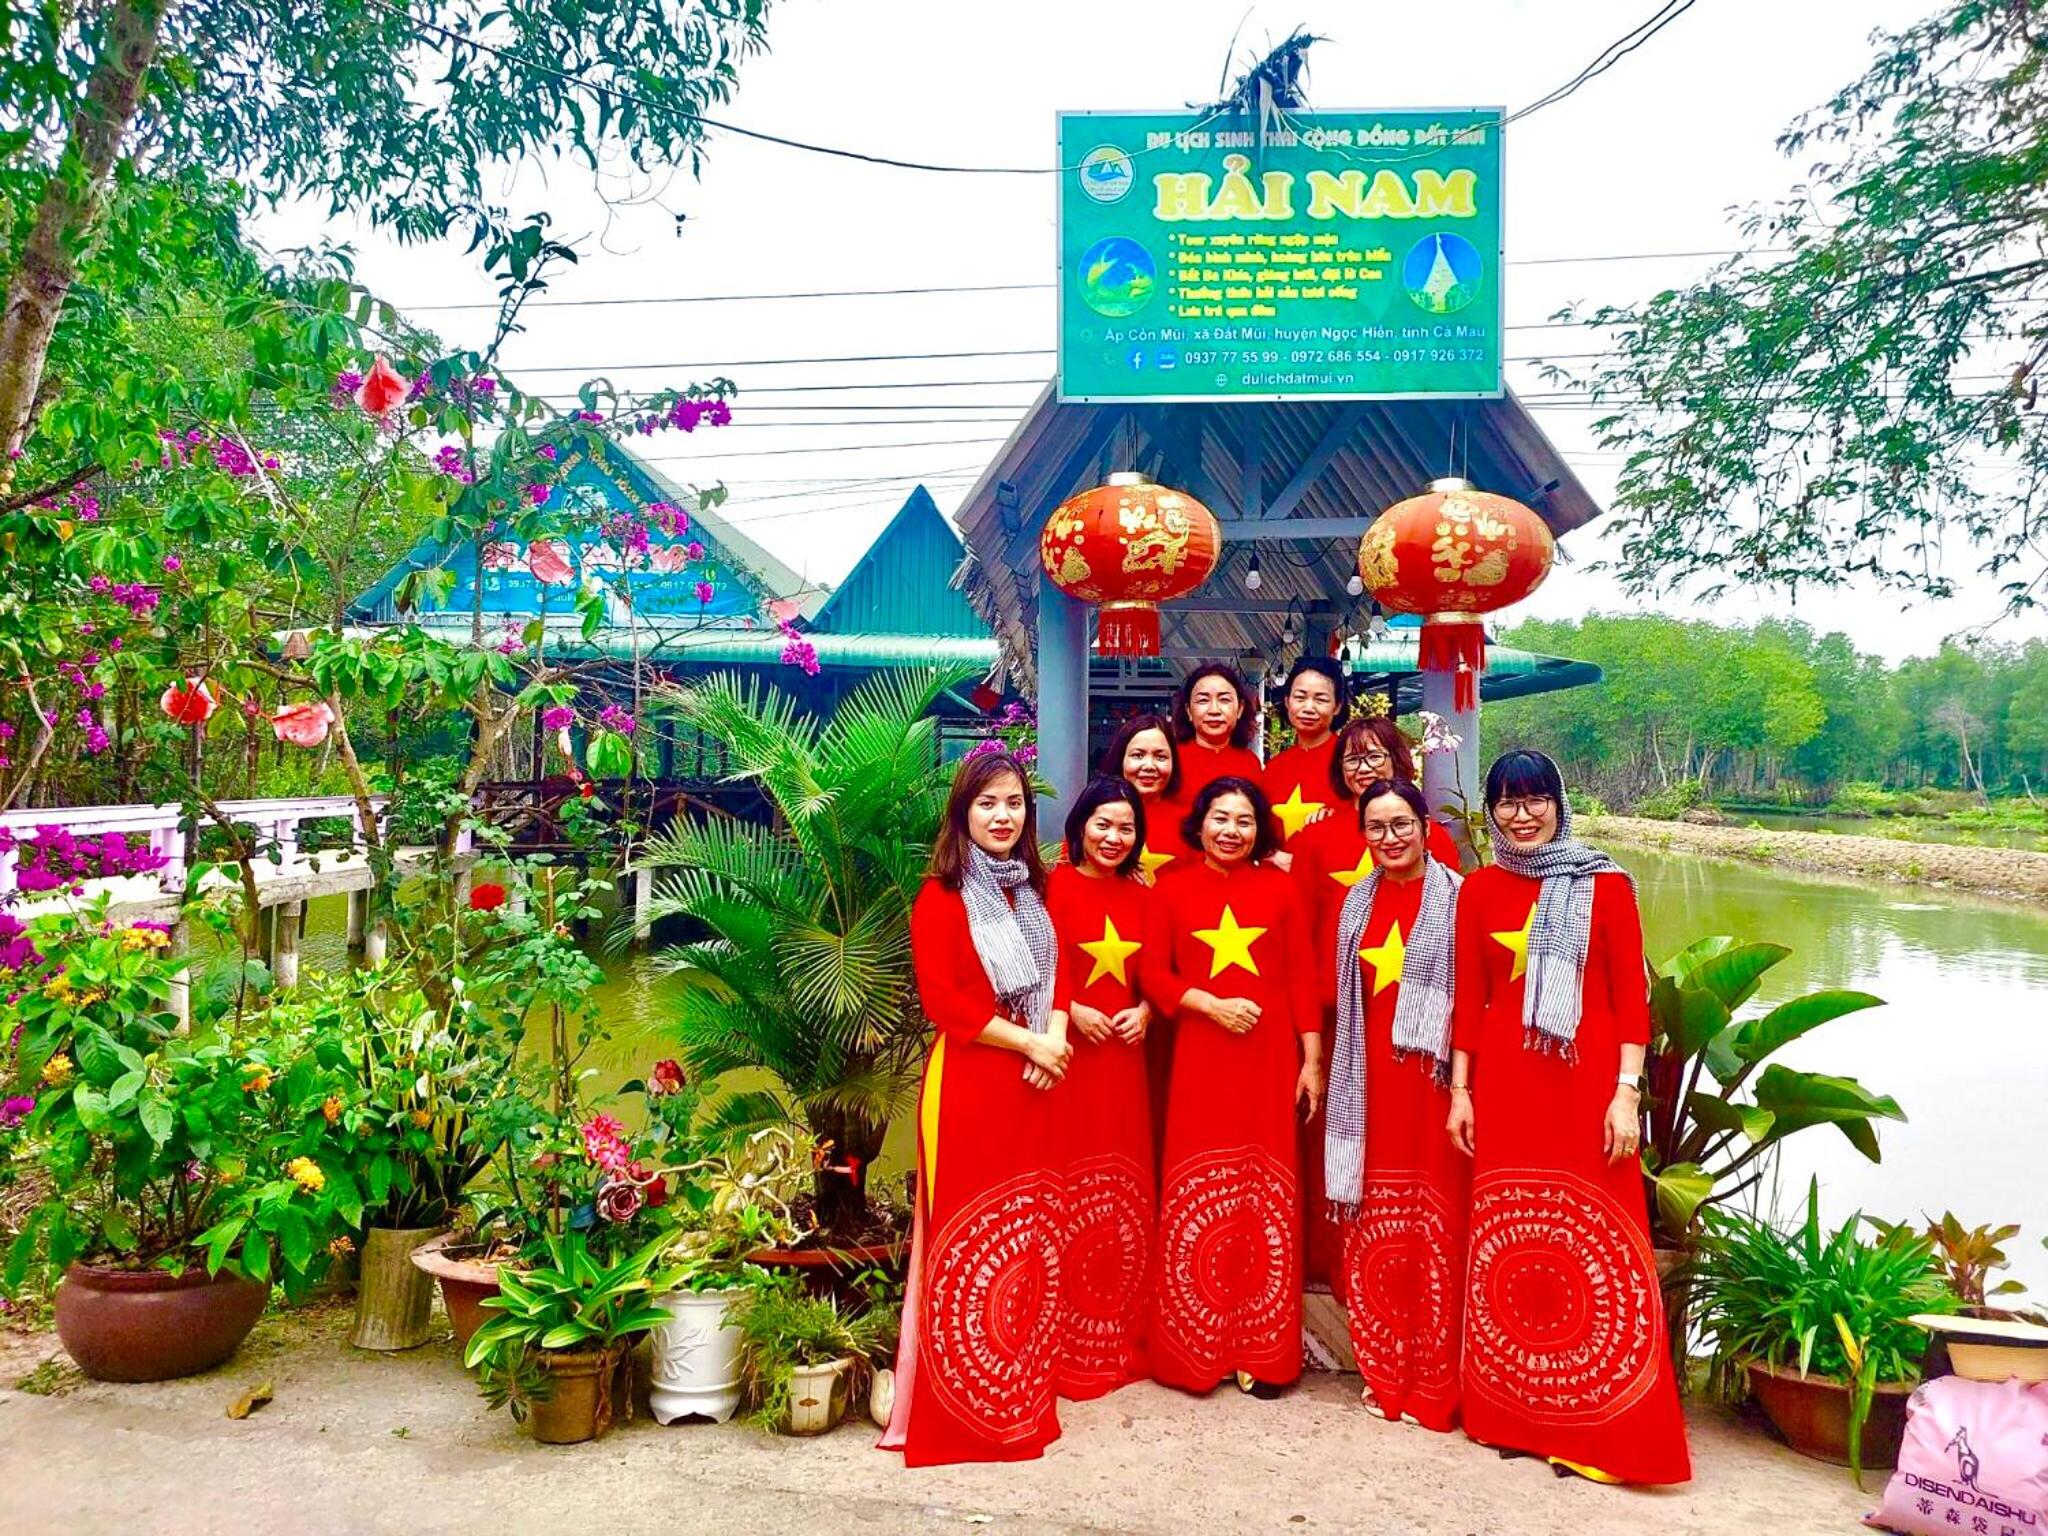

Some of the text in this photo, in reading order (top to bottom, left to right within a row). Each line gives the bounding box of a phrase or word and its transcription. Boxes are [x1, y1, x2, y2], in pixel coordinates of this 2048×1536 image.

[1175, 132, 1210, 154] LỊCH
[1215, 131, 1255, 148] SINH
[1153, 154, 1477, 220] HẢI NAM
[1178, 234, 1206, 246] Tour
[1194, 328, 1209, 340] xã
[1321, 326, 1357, 342] Ngọc
[1456, 325, 1485, 338] Mau
[1185, 351, 1217, 364] 0937
[1222, 351, 1237, 364] 77
[1242, 351, 1258, 364] 55
[1262, 351, 1279, 363] 99
[1291, 350, 1323, 363] 0972
[1327, 350, 1352, 363] 686
[1356, 350, 1381, 362] 554
[1393, 349, 1426, 362] 0917
[1430, 349, 1455, 362] 926
[1459, 349, 1484, 361] 372
[1242, 372, 1354, 386] dulichdatmui.vn
[1905, 1473, 2036, 1526] DISENDAISHU
